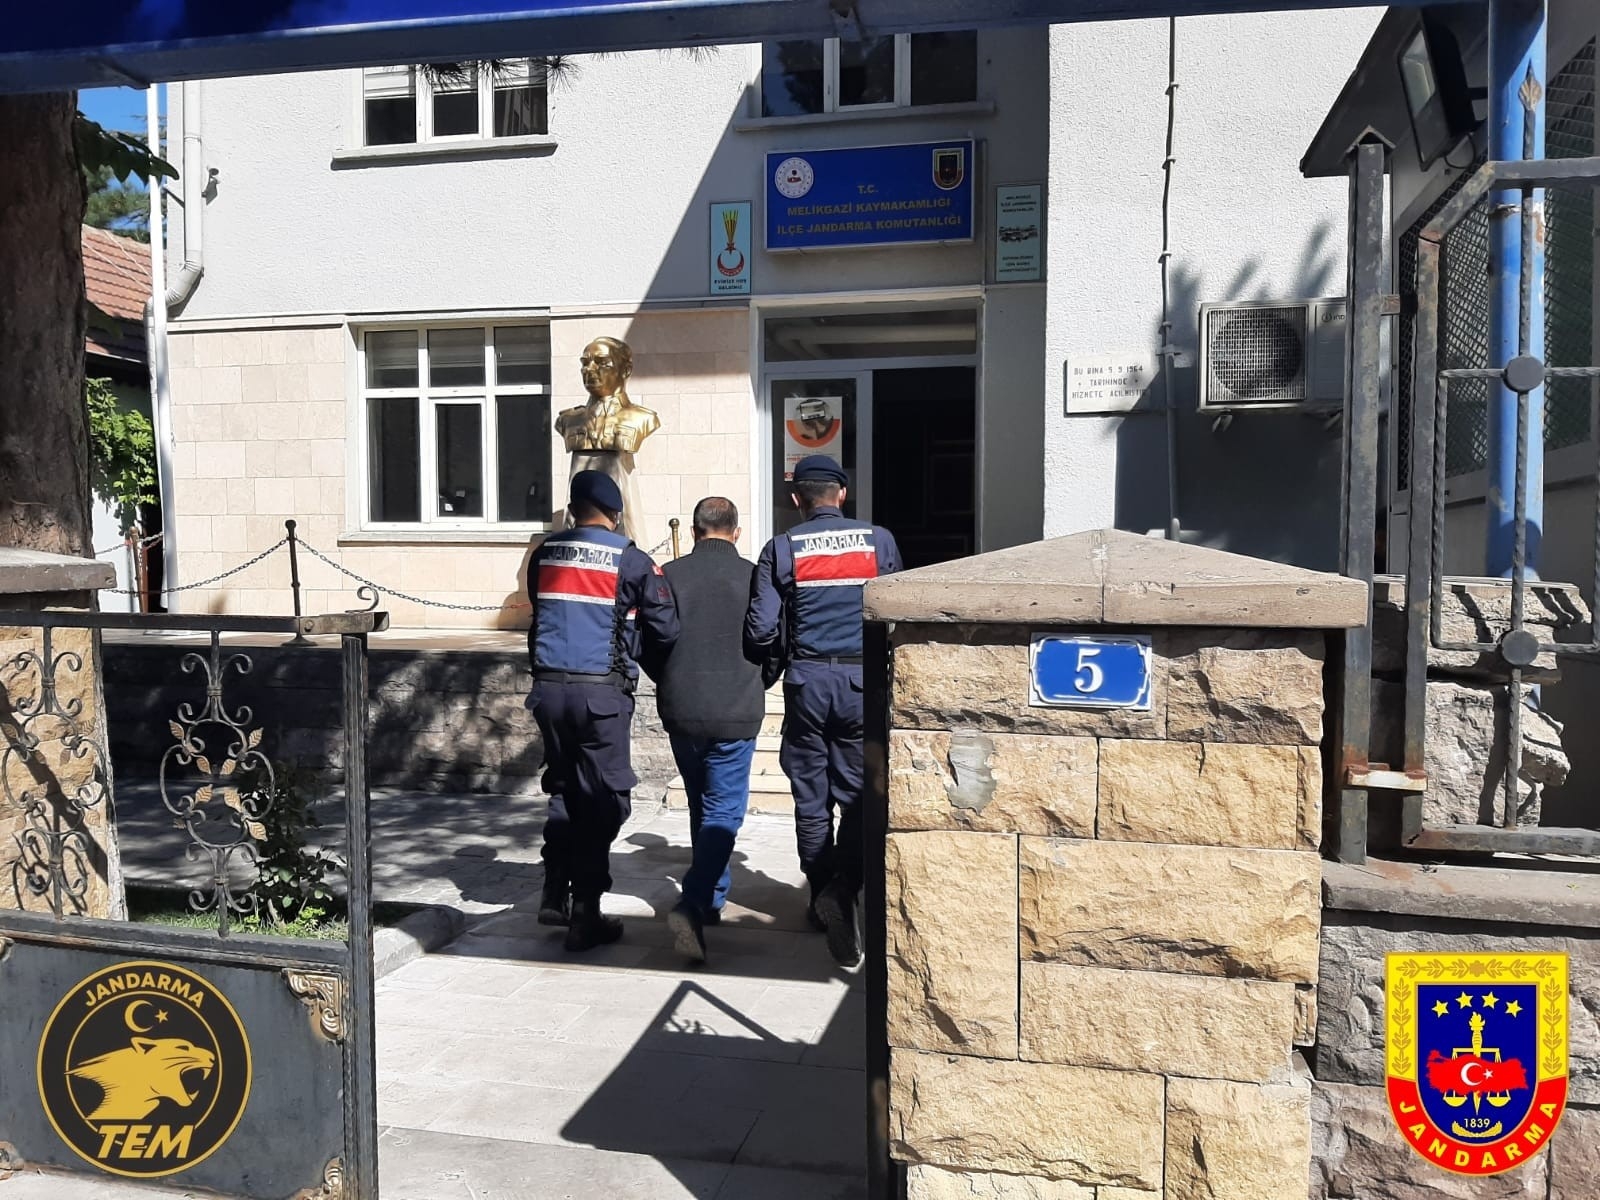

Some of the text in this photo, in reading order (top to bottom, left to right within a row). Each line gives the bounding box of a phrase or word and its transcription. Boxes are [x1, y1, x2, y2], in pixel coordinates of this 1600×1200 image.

[857, 184, 879, 195] T.C.
[807, 221, 873, 234] JANDARMA
[801, 534, 867, 552] JANDARMA
[549, 546, 614, 568] JANDARMA
[1074, 648, 1103, 693] 5
